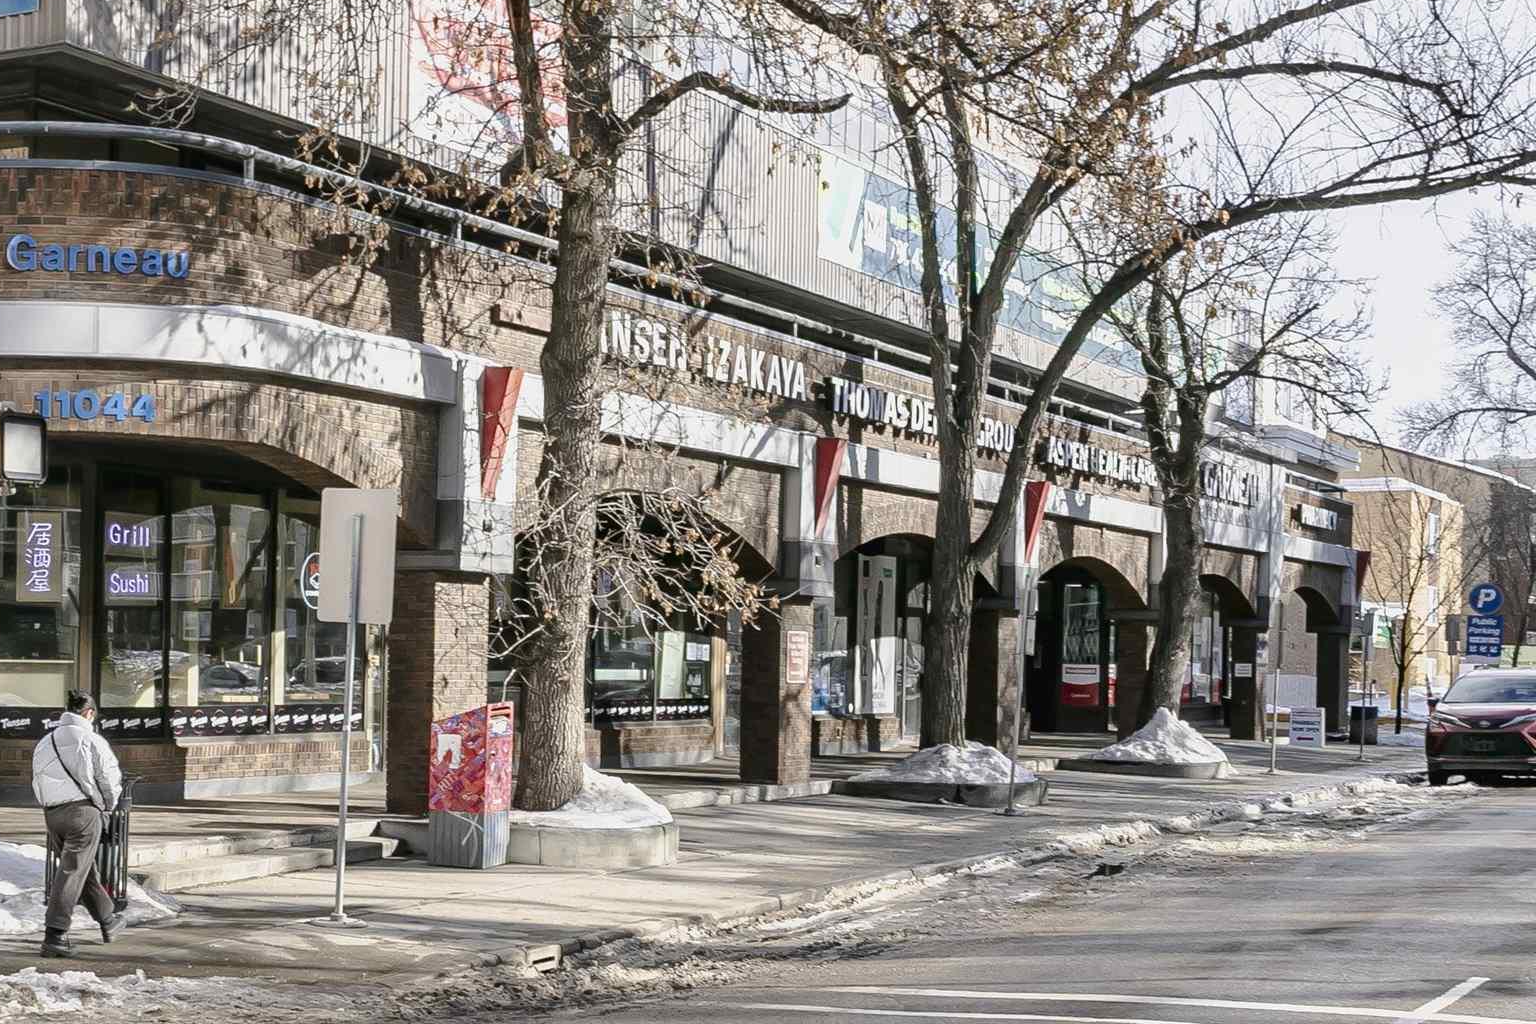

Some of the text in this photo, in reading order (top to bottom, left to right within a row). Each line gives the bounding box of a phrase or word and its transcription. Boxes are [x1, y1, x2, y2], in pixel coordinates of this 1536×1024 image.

[6, 233, 190, 279] Garneau
[706, 335, 807, 401] IZAKAYA
[35, 388, 156, 422] 11044
[832, 376, 909, 428] THOMAS
[26, 522, 52, 592] 居酒屋
[109, 524, 150, 547] Grill
[109, 573, 149, 594] Sushi
